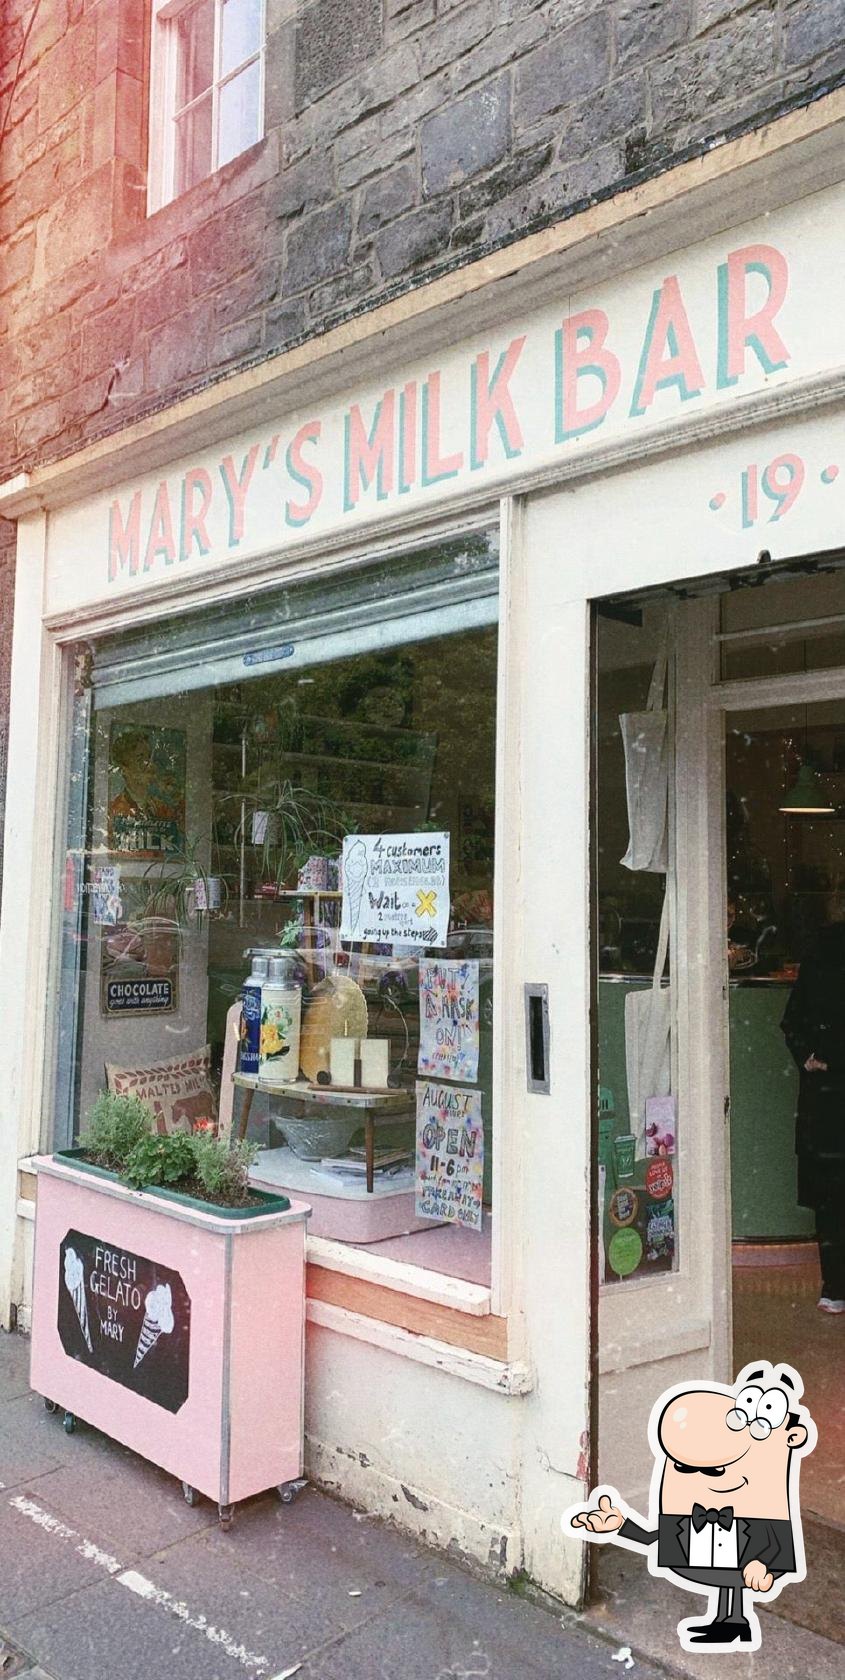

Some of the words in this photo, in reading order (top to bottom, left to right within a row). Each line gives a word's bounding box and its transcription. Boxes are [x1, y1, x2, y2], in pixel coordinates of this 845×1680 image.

[108, 421, 324, 583] MARY'S
[343, 334, 527, 512] MILK
[554, 243, 791, 443] BAR
[373, 838, 385, 858] 4
[387, 842, 441, 857] customers
[370, 858, 446, 875] MAXIMUM
[368, 891, 401, 910] Wait
[378, 912, 383, 921] 2
[363, 928, 381, 941] going
[382, 929, 389, 939] up
[391, 928, 401, 936] the
[403, 928, 422, 941] steps
[110, 983, 169, 997] CHOCOLATE
[136, 1083, 181, 1100] MALTED
[422, 1087, 473, 1112] AUGUST
[422, 1123, 478, 1158] OPEN
[420, 1200, 455, 1218] CARD
[95, 1247, 137, 1282] FRESH
[90, 1271, 141, 1310] GELATO
[107, 1305, 118, 1321] BY
[100, 1320, 125, 1343] MARY
